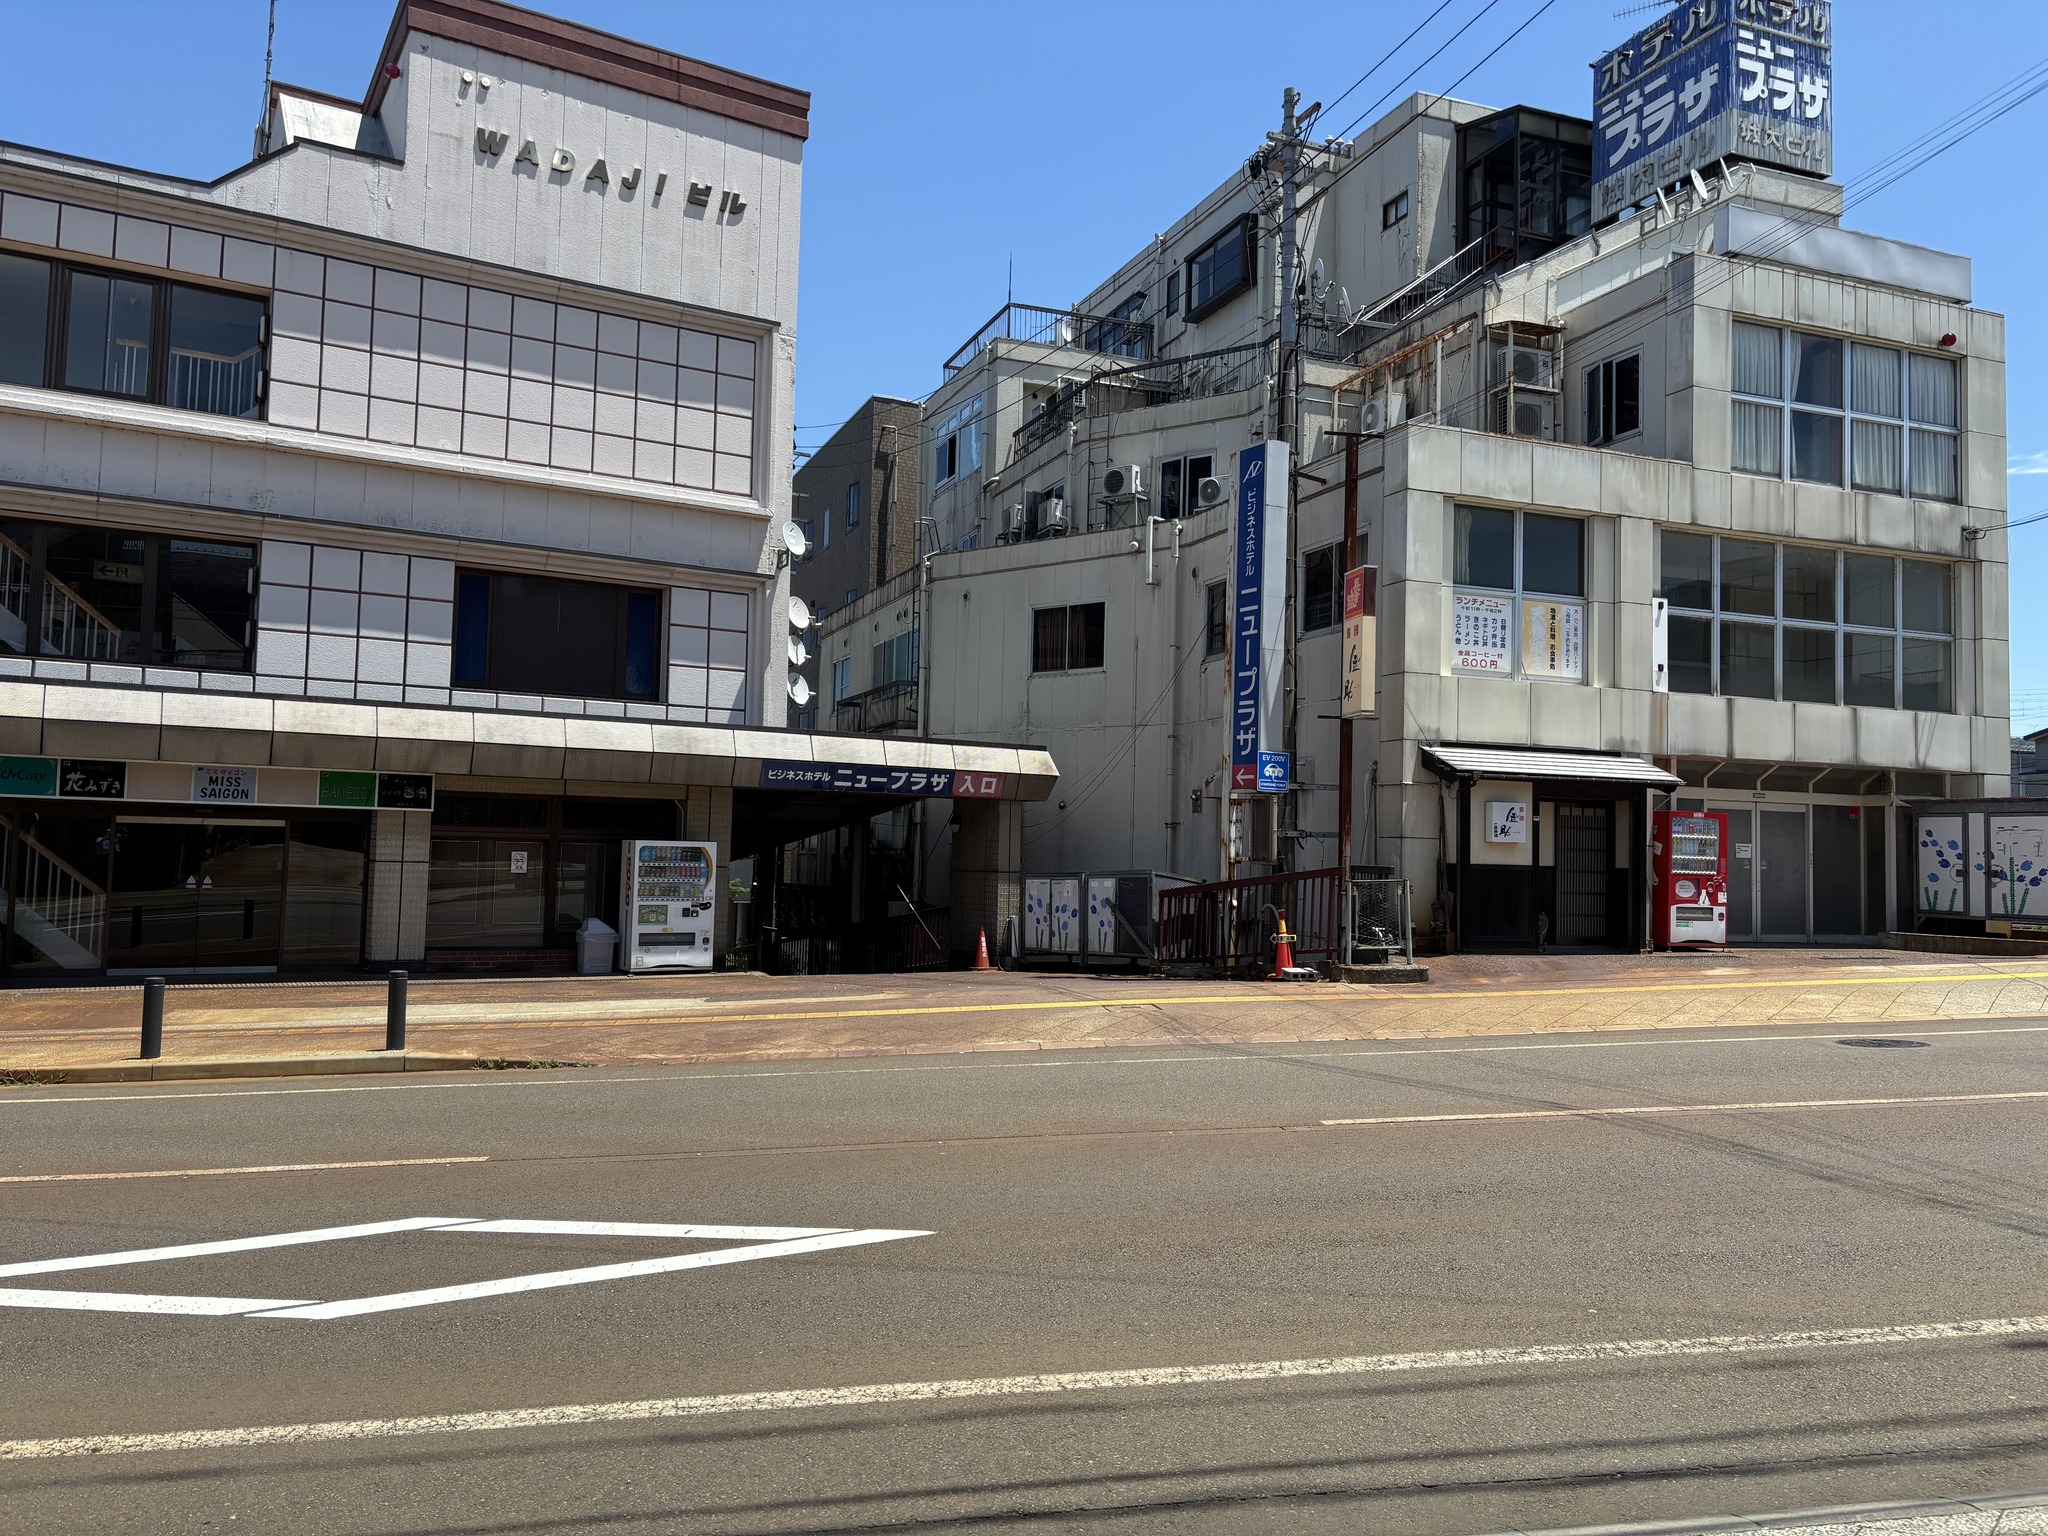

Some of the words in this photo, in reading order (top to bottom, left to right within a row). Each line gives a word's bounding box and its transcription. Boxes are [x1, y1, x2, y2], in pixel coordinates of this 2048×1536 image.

[1601, 0, 1719, 93] ホテル
[1737, 29, 1795, 59] ニュー
[1738, 58, 1828, 118] プラザ
[1599, 75, 1669, 130] ニュー
[1605, 63, 1719, 168] プラザ
[477, 127, 667, 196] WADAJI
[687, 182, 747, 215] ビル
[1244, 488, 1258, 576] ビジネスホテル
[1456, 596, 1507, 608] ランチメニュー
[1236, 586, 1259, 757] ニュープラザ
[1462, 658, 1498, 669] 600円
[76, 762, 112, 772] Lounge
[64, 771, 121, 794] 花みずき
[200, 787, 249, 799] SAIGON
[208, 776, 242, 787] MISS
[768, 769, 831, 782] ビジネスホテル
[834, 769, 950, 792] ニュープラザ
[958, 775, 998, 794] 入口
